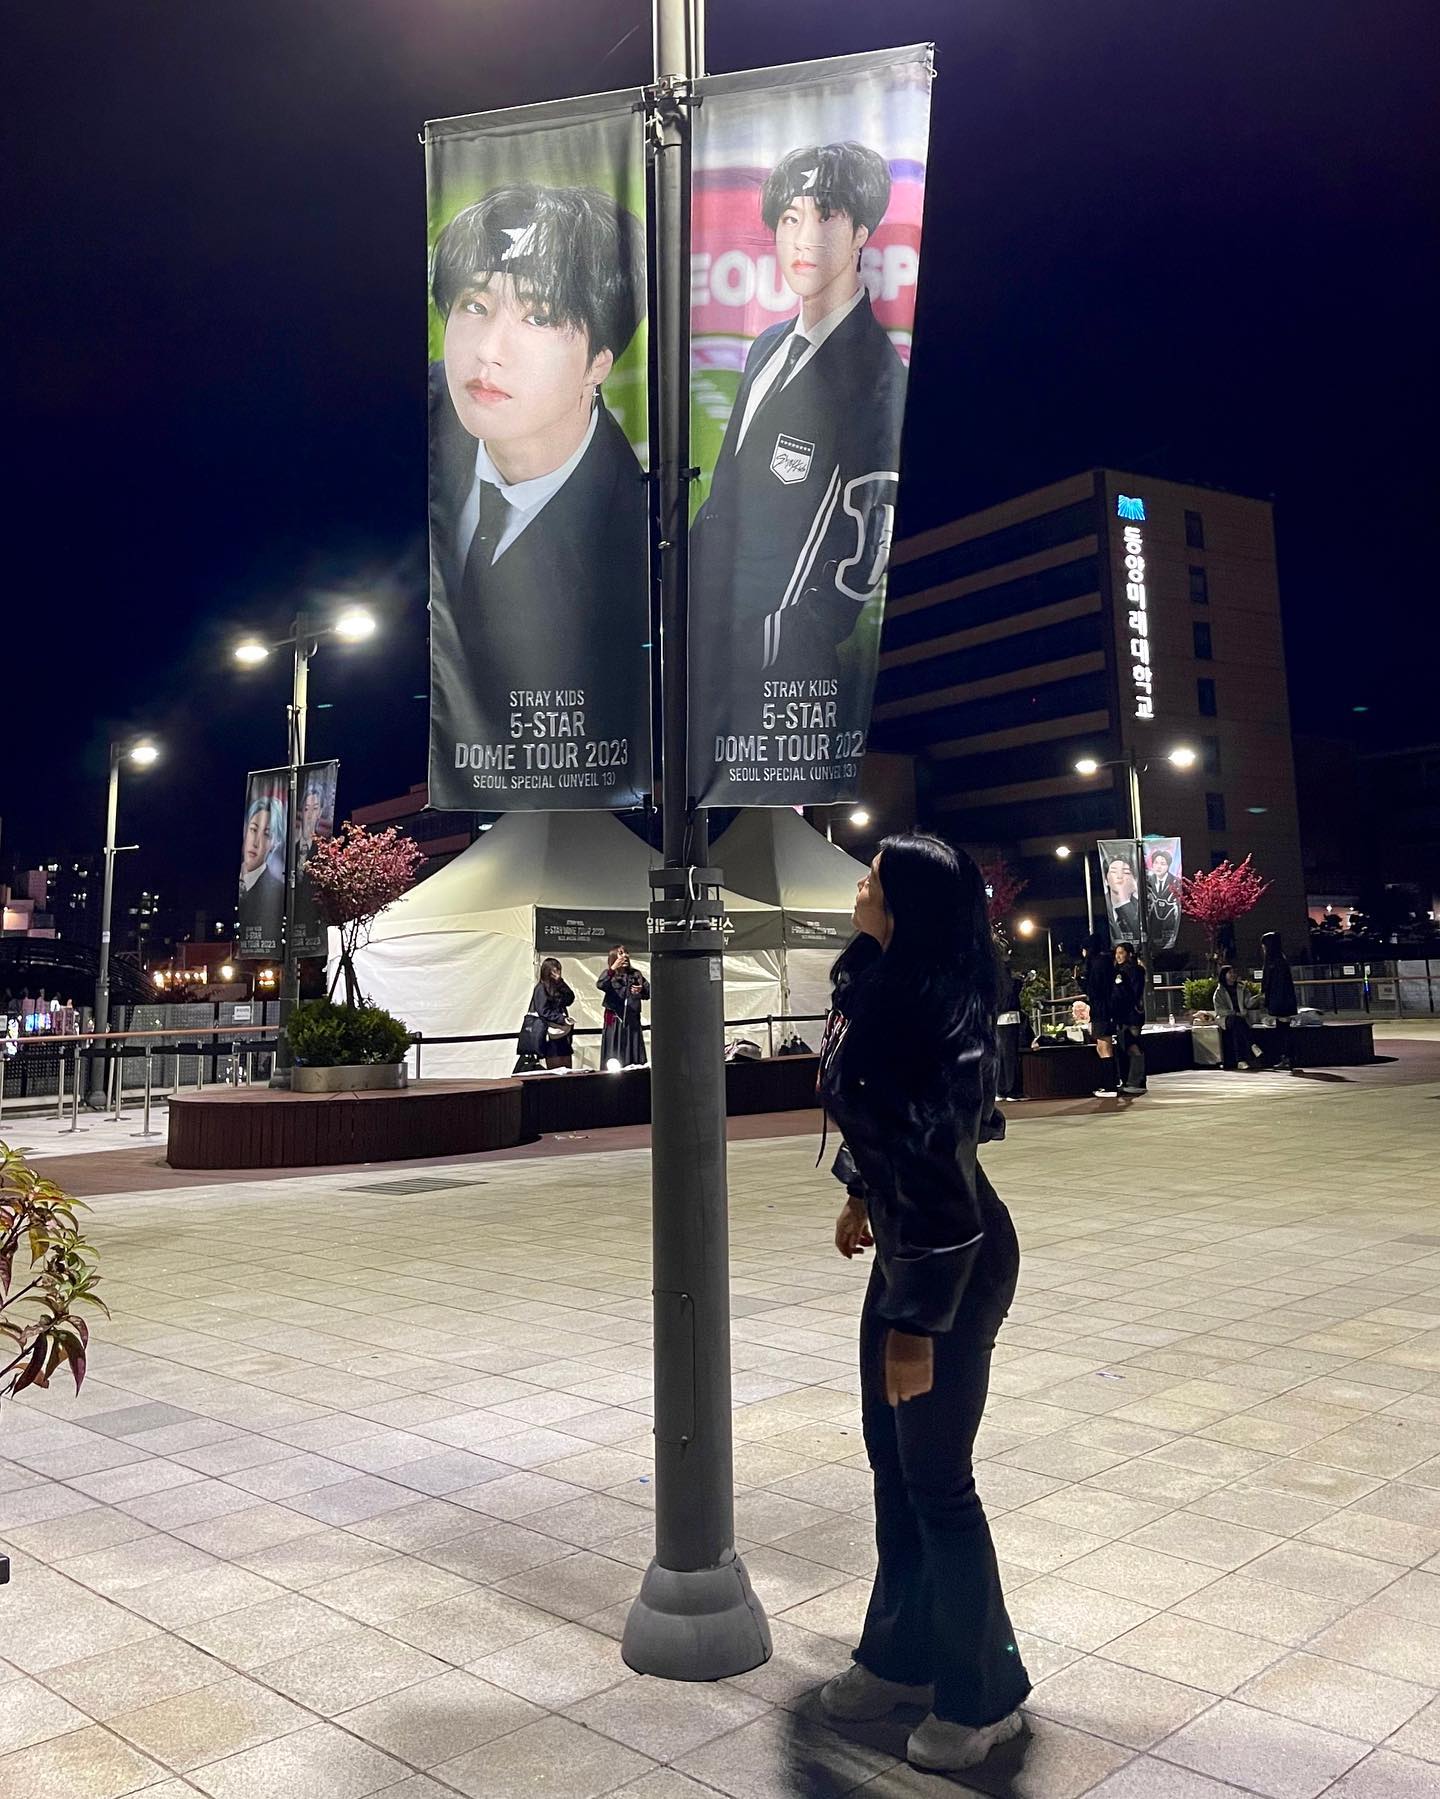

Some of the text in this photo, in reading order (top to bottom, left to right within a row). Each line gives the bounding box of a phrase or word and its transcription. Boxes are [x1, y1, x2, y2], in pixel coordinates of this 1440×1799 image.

[1123, 526, 1154, 719] 동양미래대학교
[509, 689, 585, 707] STRAY KIDS
[763, 679, 838, 698] STRAY KIDS
[510, 711, 585, 738] 5-STAR
[762, 702, 837, 730] 5-STAR
[455, 738, 628, 770] DOME TOUR 2023
[714, 730, 866, 762] DOME TOUR 202
[473, 771, 616, 789] SEOUL SPECIAL (UNVEIL 13)
[729, 767, 761, 782] SEOUL
[763, 766, 806, 781] SPECIAL
